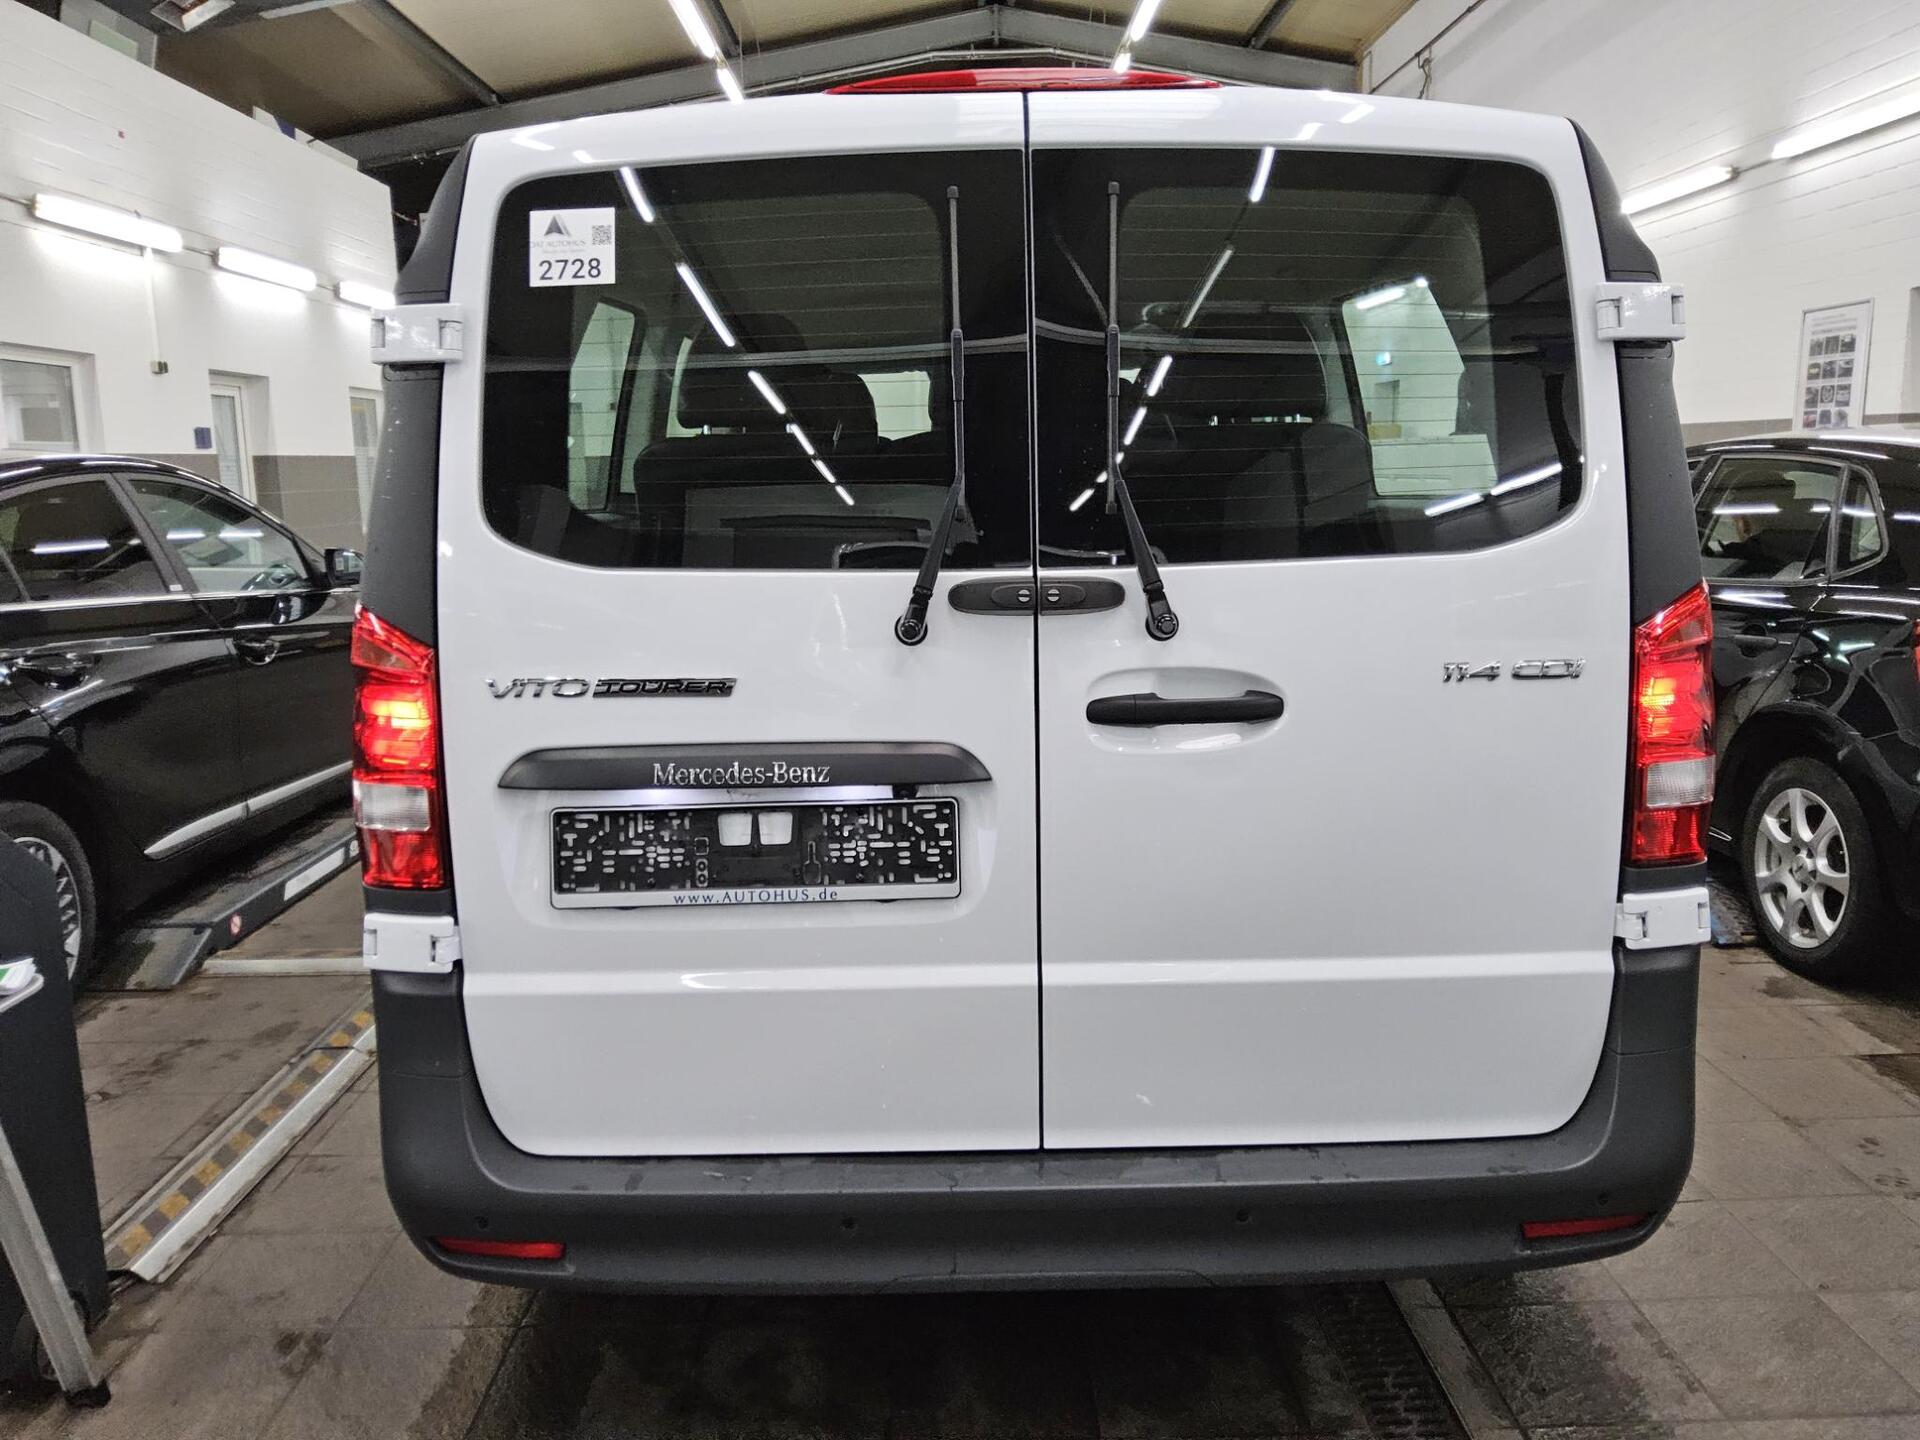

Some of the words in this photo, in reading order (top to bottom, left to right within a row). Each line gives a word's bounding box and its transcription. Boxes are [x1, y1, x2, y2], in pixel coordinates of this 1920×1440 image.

[539, 258, 601, 281] 2728
[1442, 661, 1501, 683] 114
[1510, 657, 1586, 681] CDI
[485, 678, 591, 698] VITO
[599, 679, 735, 696] TOURER
[652, 761, 831, 785] Mercedes-Benz
[673, 887, 838, 904] www.AUTOHUS.de
